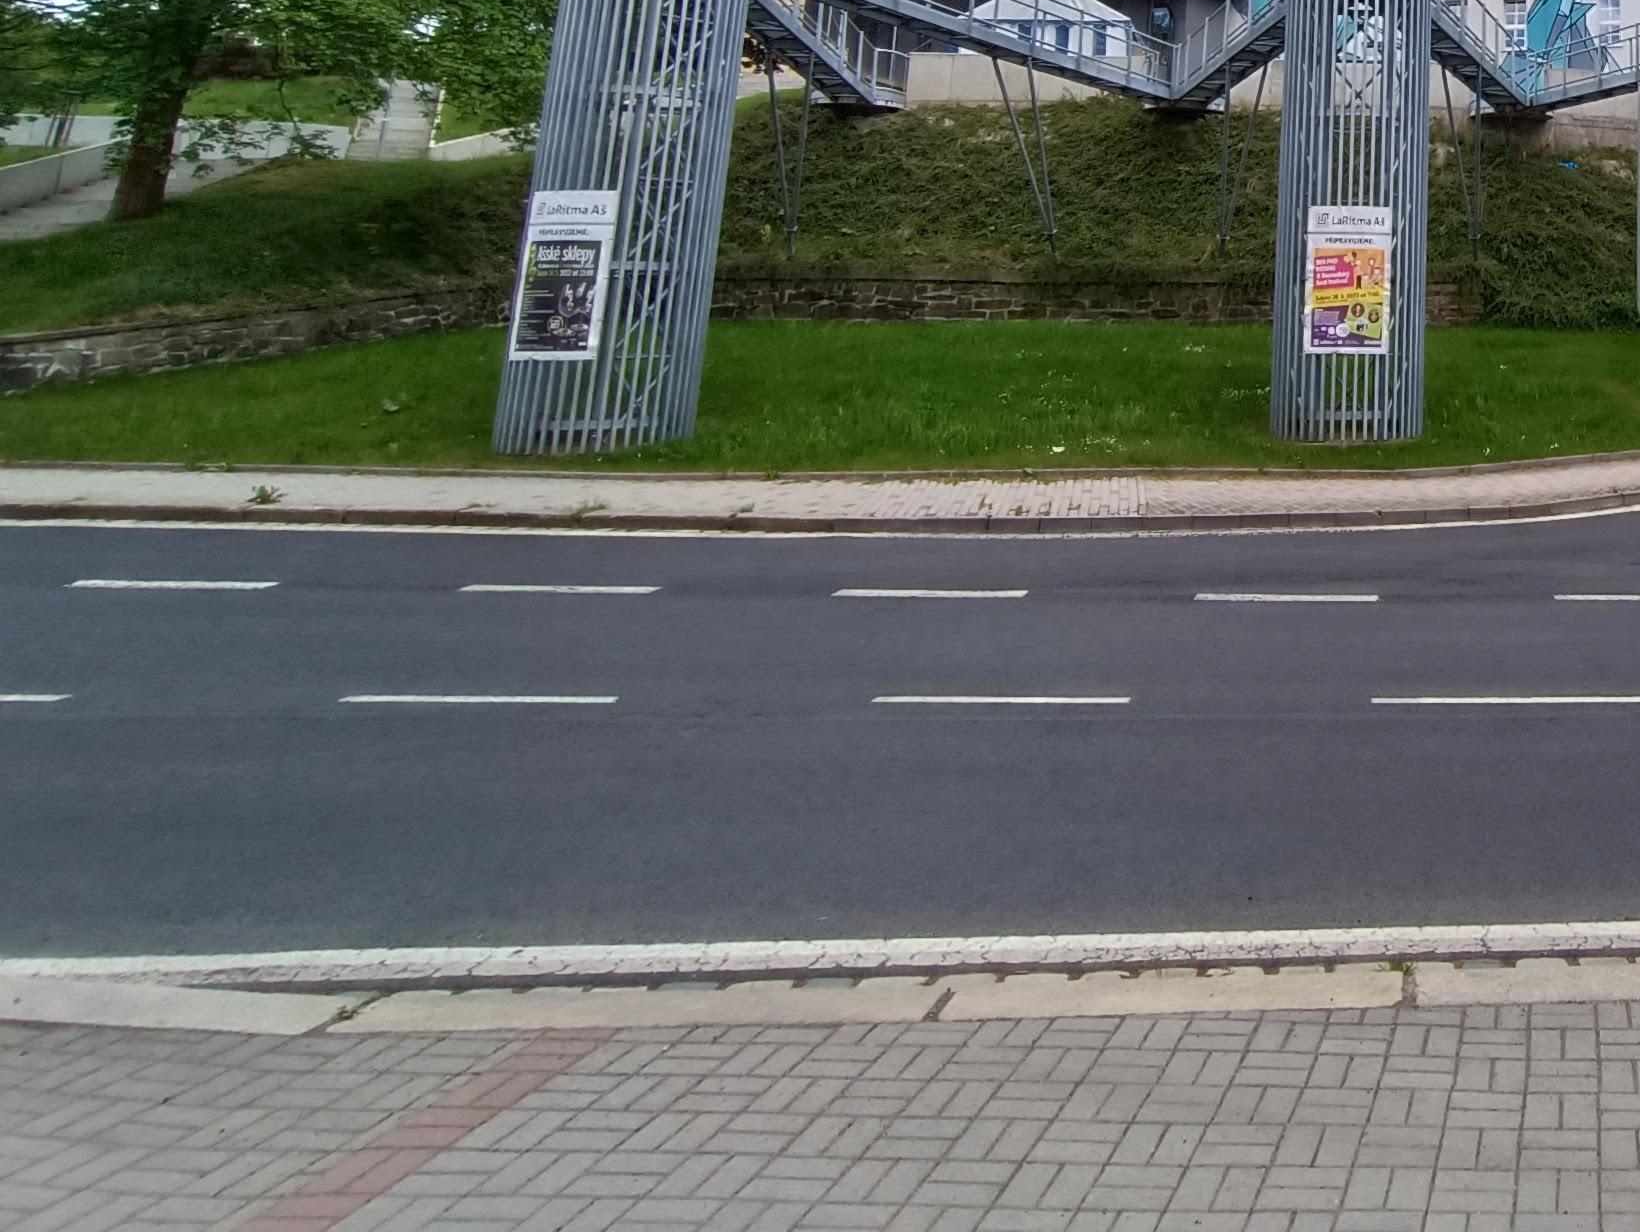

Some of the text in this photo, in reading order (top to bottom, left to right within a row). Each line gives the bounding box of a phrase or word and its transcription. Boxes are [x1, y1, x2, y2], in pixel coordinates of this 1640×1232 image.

[546, 204, 607, 215] LaRitma Aš
[1332, 216, 1371, 226] LaRitma
[561, 245, 596, 266] sklepy
